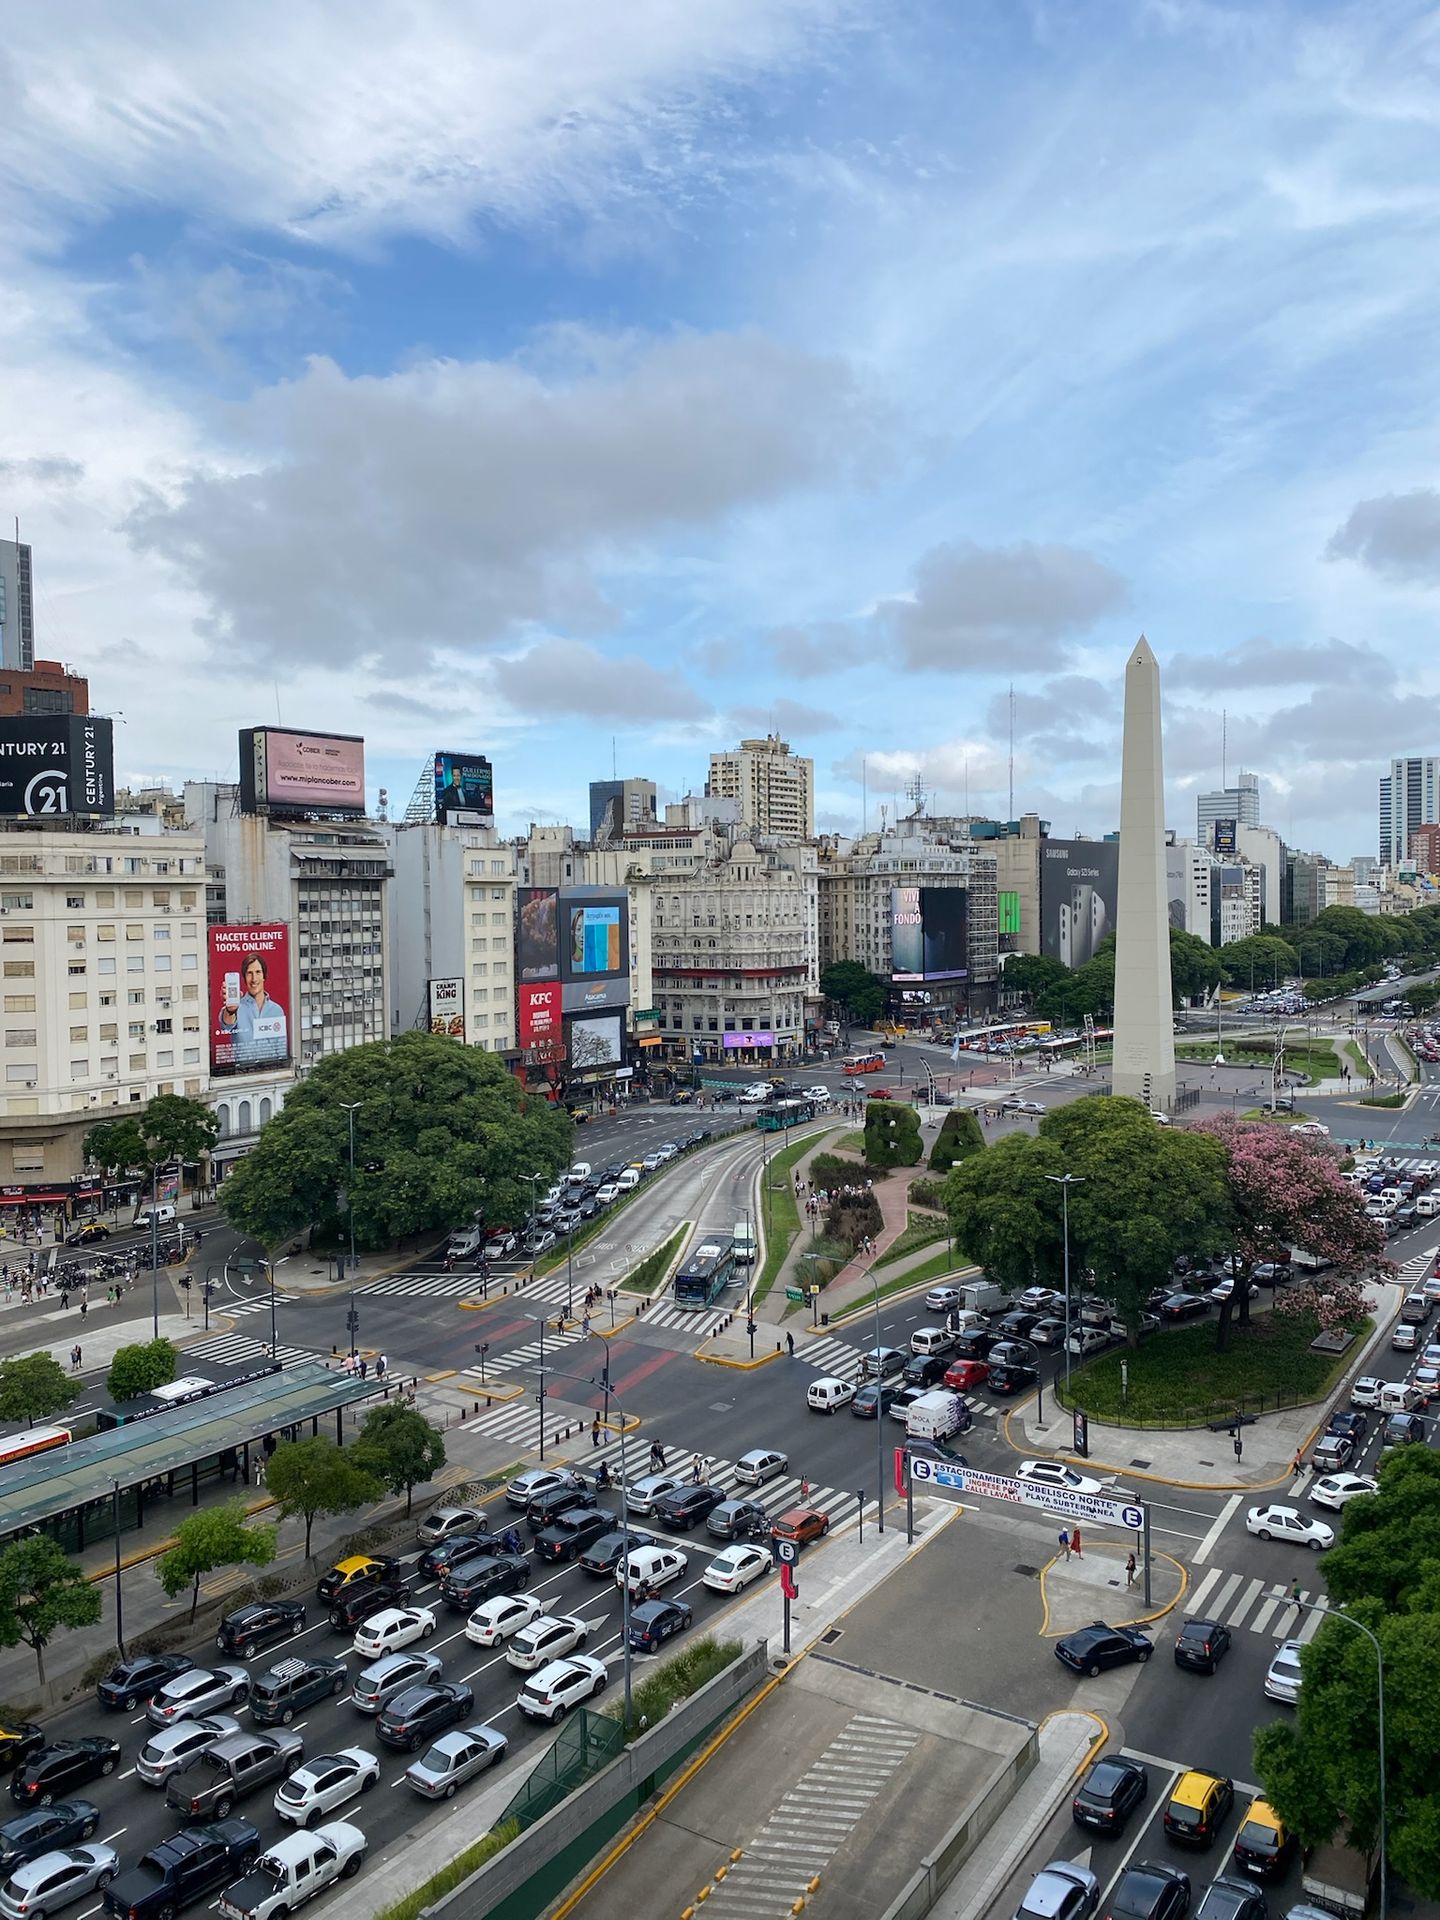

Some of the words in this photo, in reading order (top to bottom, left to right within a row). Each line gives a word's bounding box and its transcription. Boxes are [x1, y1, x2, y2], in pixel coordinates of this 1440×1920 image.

[302, 746, 321, 754] COBER
[85, 741, 96, 804] CENTURY
[280, 774, 356, 787] www.miplancober.com
[1045, 848, 1069, 859] SAMSUNG
[894, 913, 921, 925] FONDO
[215, 932, 249, 942] HACETE
[250, 931, 284, 940] CLIENTE
[215, 942, 241, 952] 100%
[242, 941, 276, 951] ONLINE.
[436, 989, 457, 1000] KING
[529, 991, 552, 1005] KFC
[259, 1024, 273, 1032] ICBC
[934, 1463, 1021, 1489] ESTACIONAMIENTO
[968, 1479, 1001, 1491] INGRESE
[965, 1484, 990, 1495] CALLE
[990, 1489, 1022, 1502] LAVALLE
[1025, 1492, 1051, 1504] PLAYA
[1043, 1503, 1070, 1514] AGRADECE
[1080, 1511, 1097, 1519] VISITA
